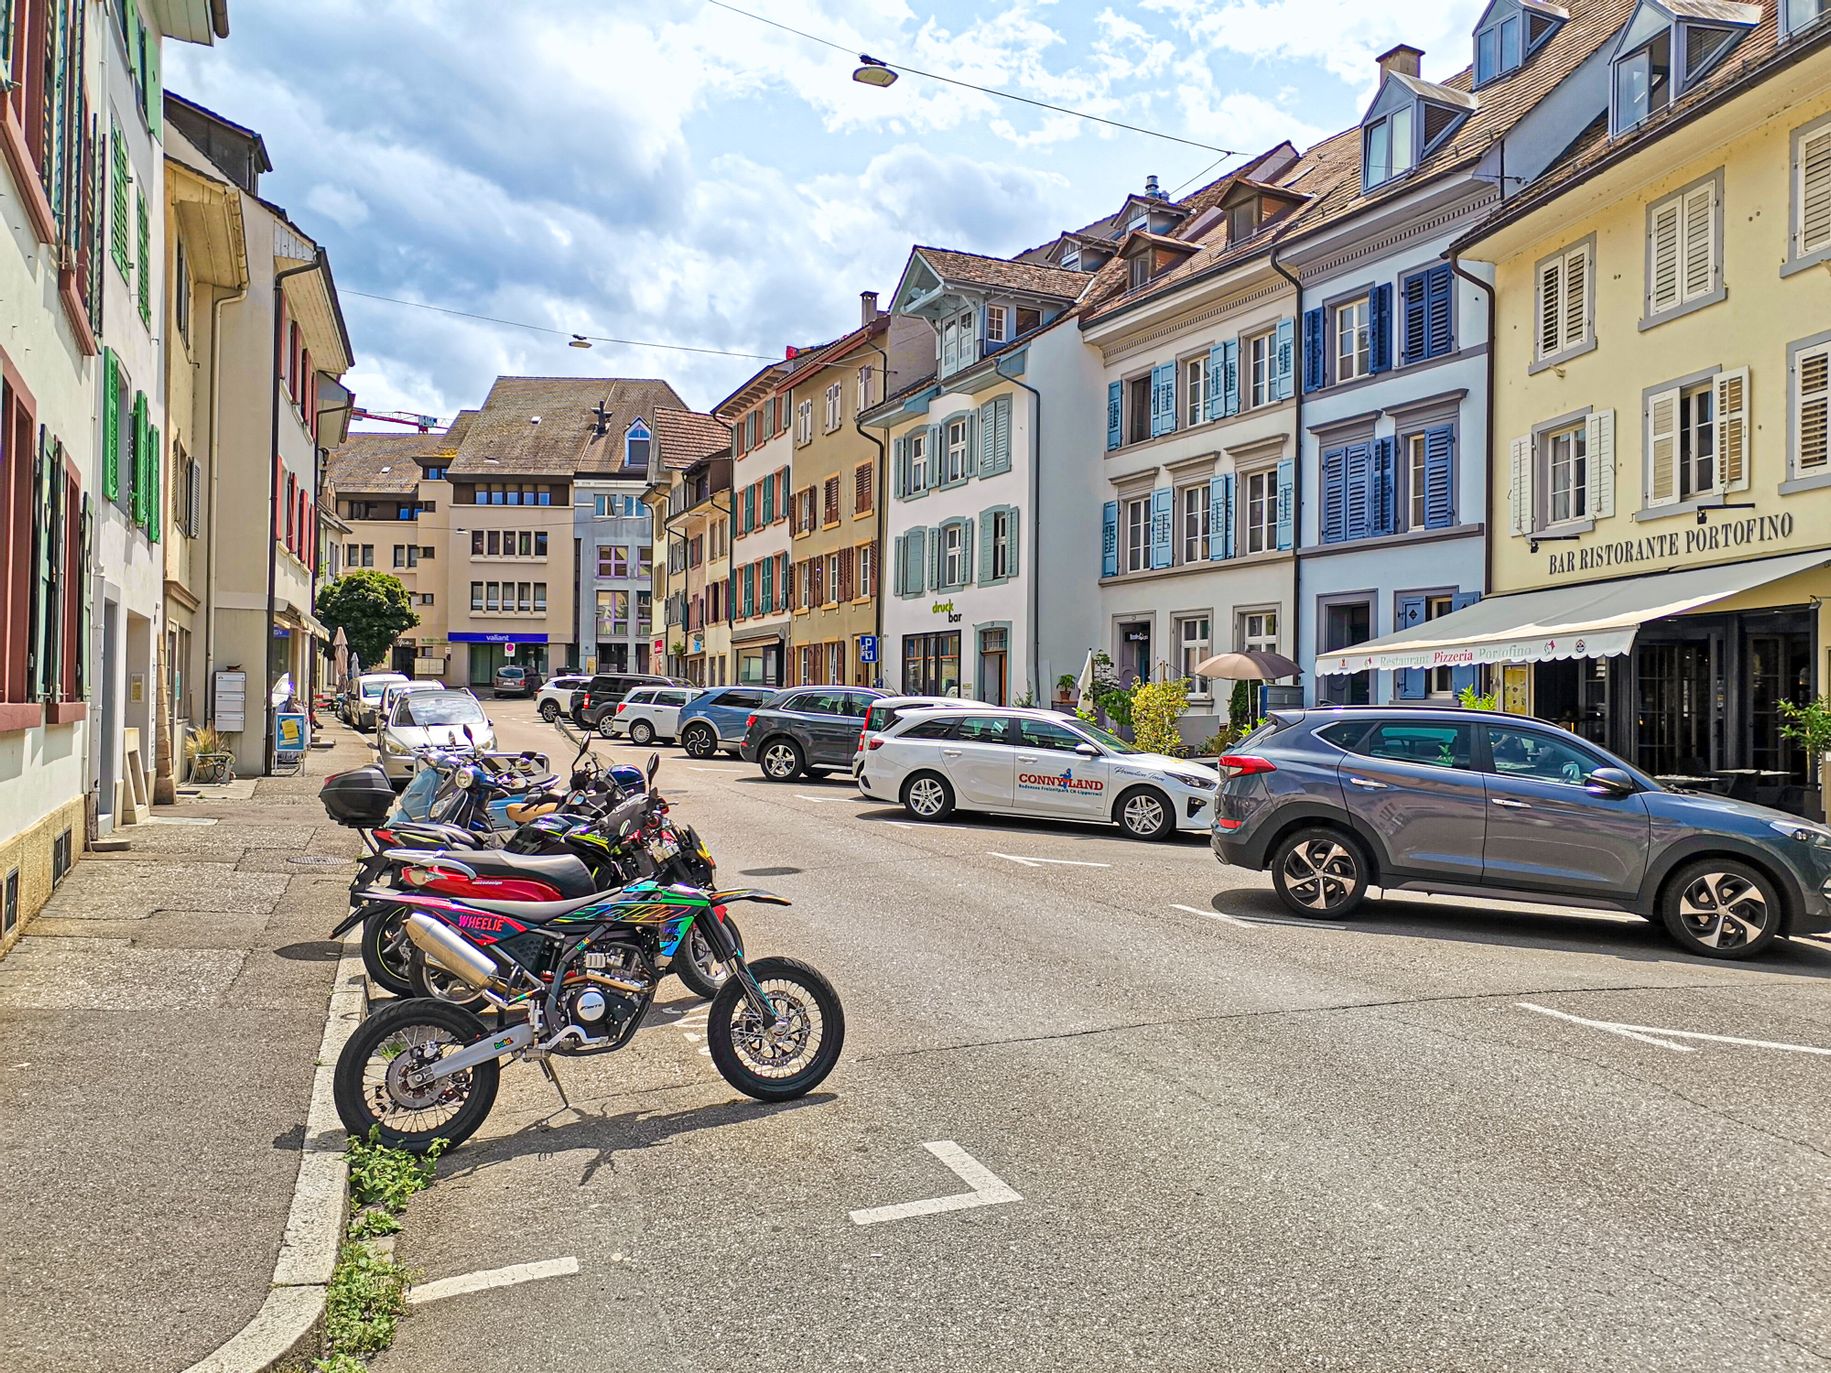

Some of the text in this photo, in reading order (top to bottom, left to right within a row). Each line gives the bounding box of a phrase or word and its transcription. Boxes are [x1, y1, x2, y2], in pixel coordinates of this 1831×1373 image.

[1549, 512, 1793, 575] BAR RISTORANTE PORTOFINO
[932, 599, 954, 614] druck
[948, 611, 962, 623] bar
[486, 634, 510, 642] valiant
[865, 637, 873, 650] P
[1380, 644, 1532, 666] Restaurant Pizzeria Portofino
[1018, 773, 1104, 791] CONNY LAND
[458, 914, 504, 932] WHEELIE
